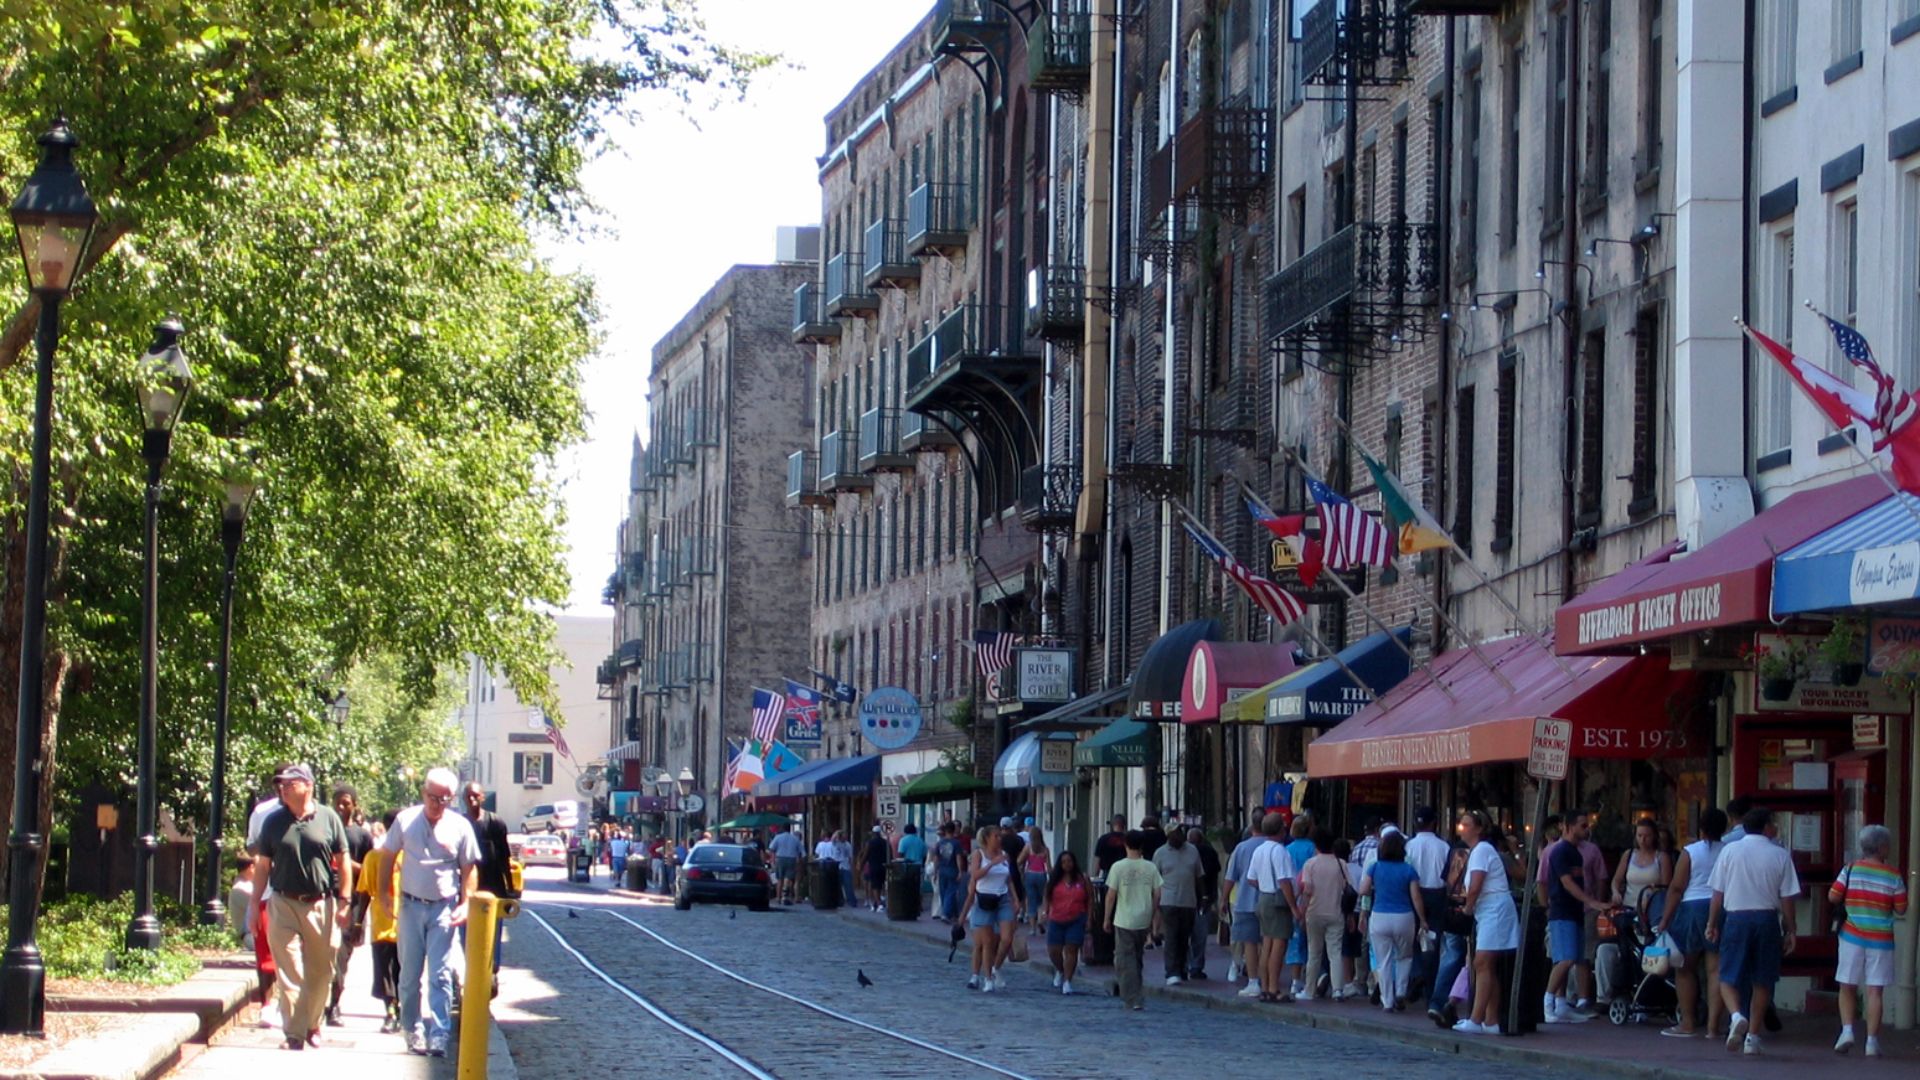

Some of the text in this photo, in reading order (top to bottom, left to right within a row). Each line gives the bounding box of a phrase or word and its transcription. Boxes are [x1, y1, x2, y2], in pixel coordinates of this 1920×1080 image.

[1886, 552, 1914, 590] Express
[1579, 582, 1721, 645] RIVERBOAT TICKET OFFICE
[1028, 663, 1062, 675] RIVER
[1028, 684, 1064, 697] GRILL
[1801, 690, 1868, 698] YOUR TICKET
[1801, 698, 1869, 708] INFORMATION
[1543, 724, 1559, 737] NO
[1534, 736, 1566, 751] PARKING
[1583, 728, 1628, 748] EST.
[881, 803, 896, 816] 15
